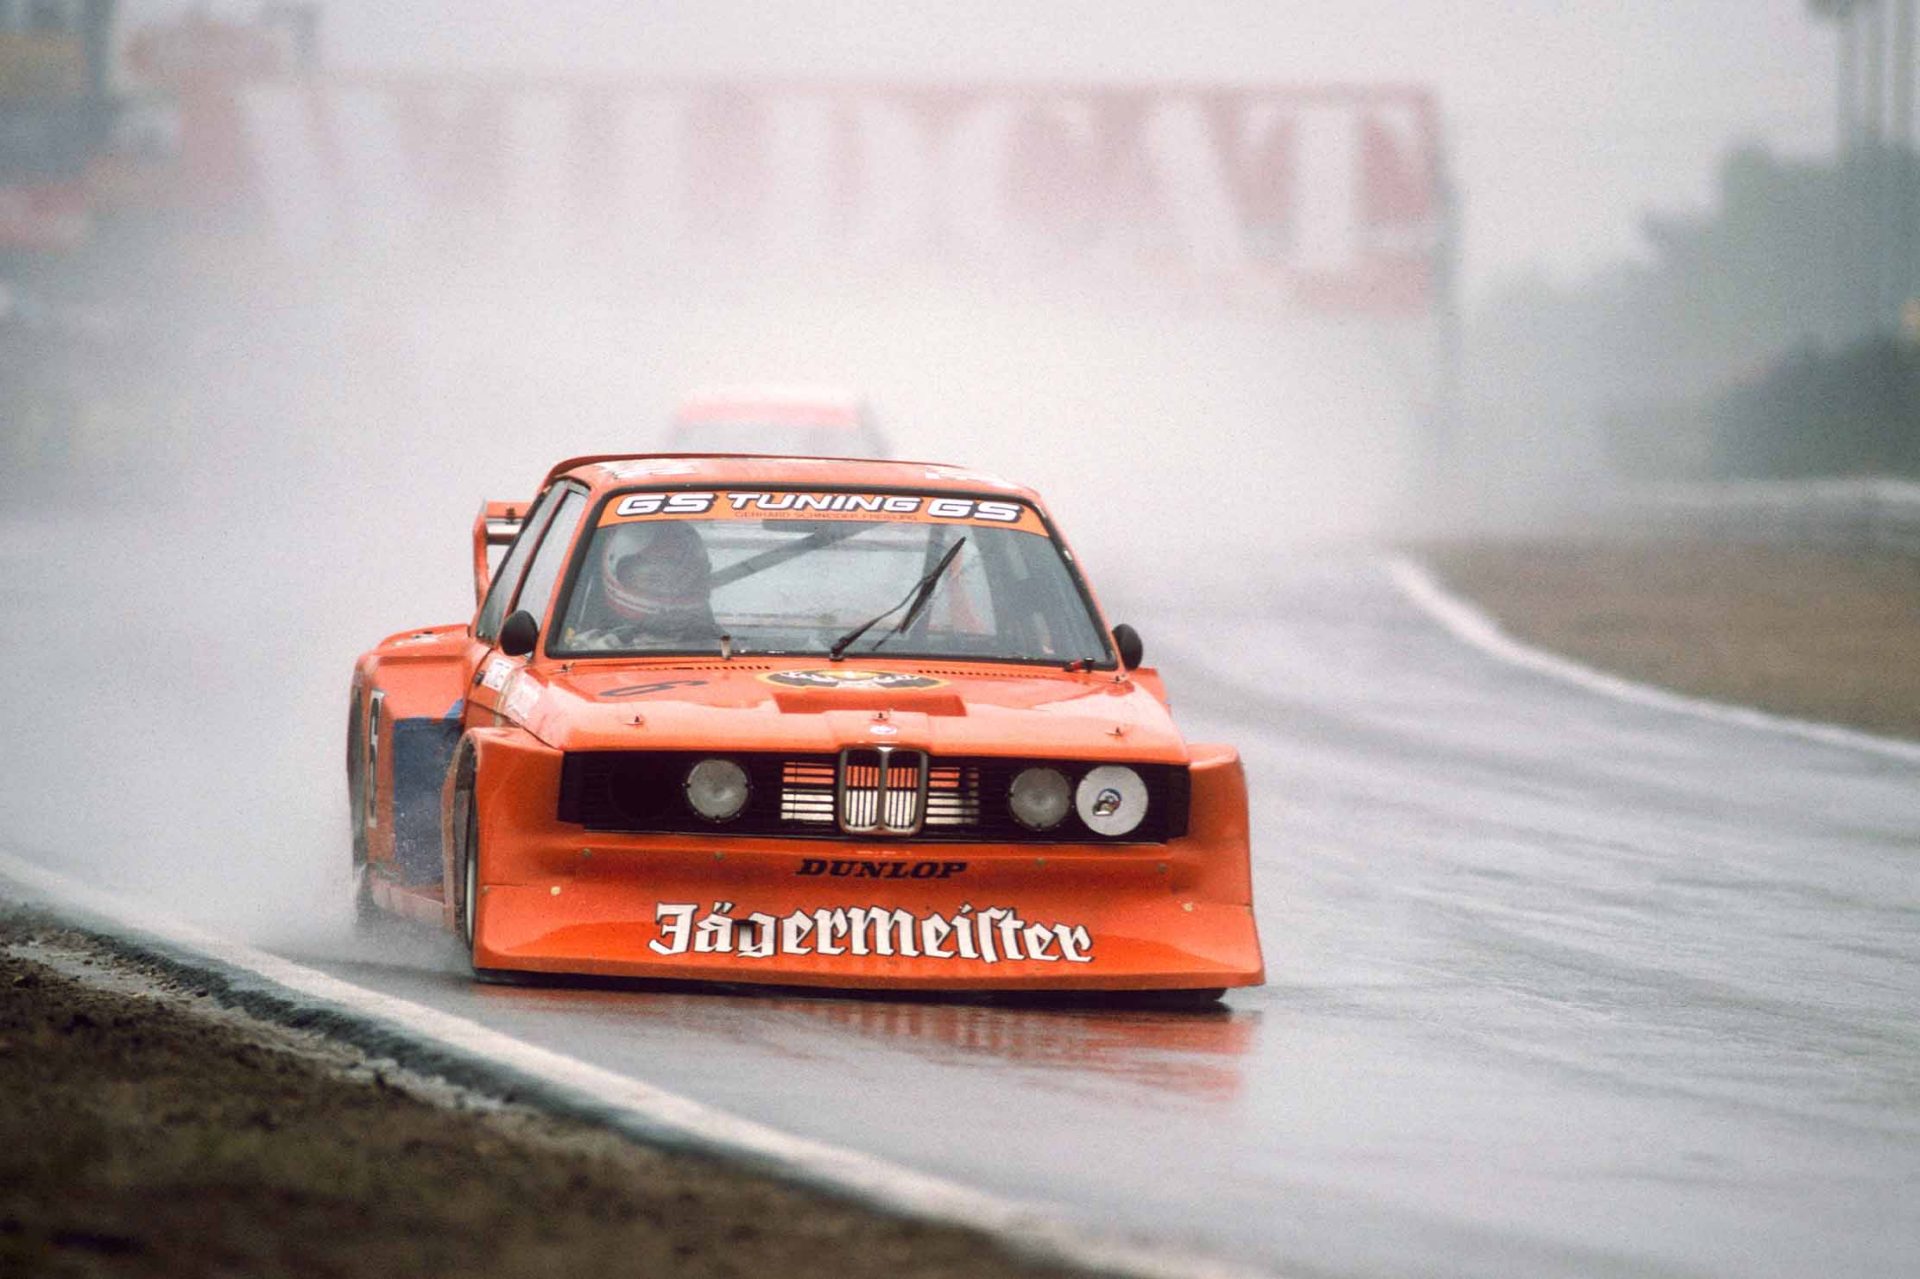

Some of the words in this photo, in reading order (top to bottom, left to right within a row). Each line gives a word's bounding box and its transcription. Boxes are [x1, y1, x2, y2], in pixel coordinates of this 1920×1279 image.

[616, 493, 717, 516] GS
[727, 493, 923, 513] TUNING
[927, 498, 1024, 523] GS
[795, 858, 968, 880] DUNLOP
